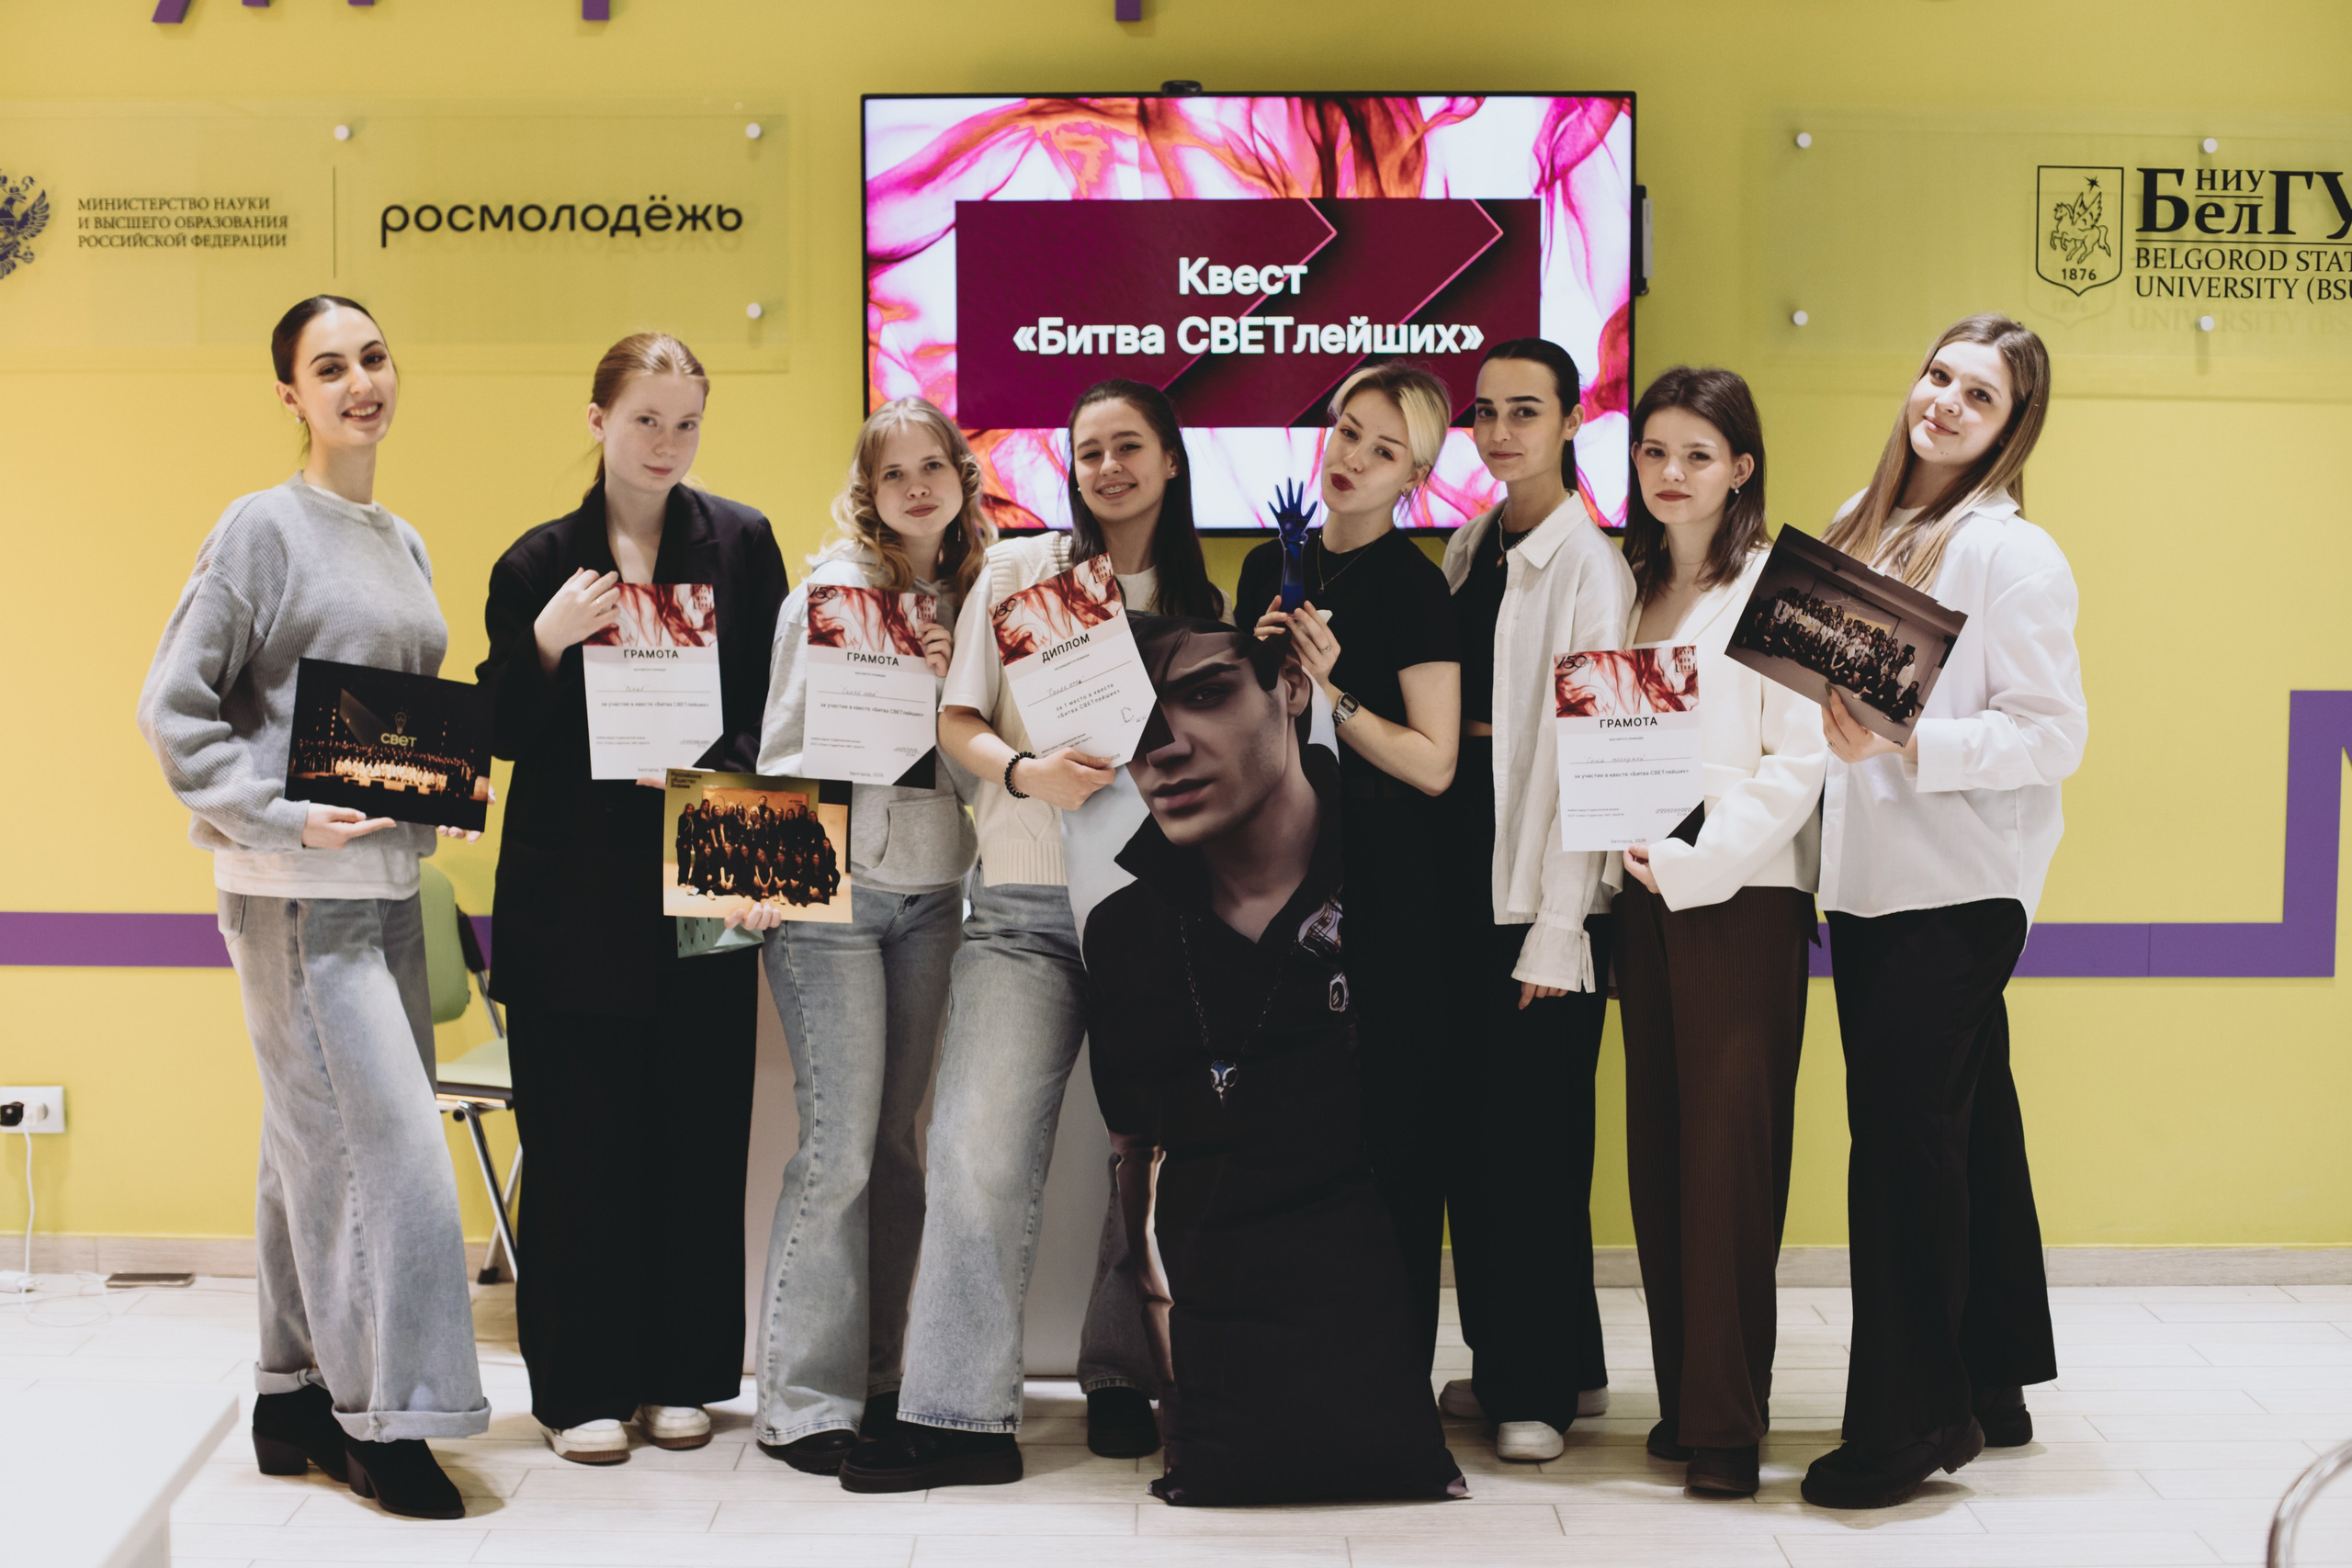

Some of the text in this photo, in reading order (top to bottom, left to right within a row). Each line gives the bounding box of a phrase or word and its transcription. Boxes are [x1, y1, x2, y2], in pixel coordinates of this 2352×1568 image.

[2196, 169, 2266, 192] НИУ
[78, 197, 270, 210] МИНИСТЕРСТВО НАУКИ
[78, 215, 288, 229] И ВЫСШЕГО ОБРАЗОВАНИЯ
[380, 195, 743, 248] росмолодёжь
[78, 232, 287, 249] РОССИЙСКОЙ ФЕДЕРАЦИИ
[2135, 247, 2288, 271] BELGOROD
[1178, 256, 1308, 295] Квест
[2061, 268, 2098, 281] 1876
[2135, 276, 2300, 299] UNIVERSITY
[1012, 315, 1485, 355] «Битва СВЕТлейших»
[624, 649, 679, 659] ГРАМОТА
[847, 652, 899, 666] ГРАМОТА
[1042, 633, 1091, 663] ДИПЛОМ
[1069, 695, 1087, 705] место
[1093, 683, 1114, 694] квесте
[1600, 716, 1657, 728] ГРАМОТА
